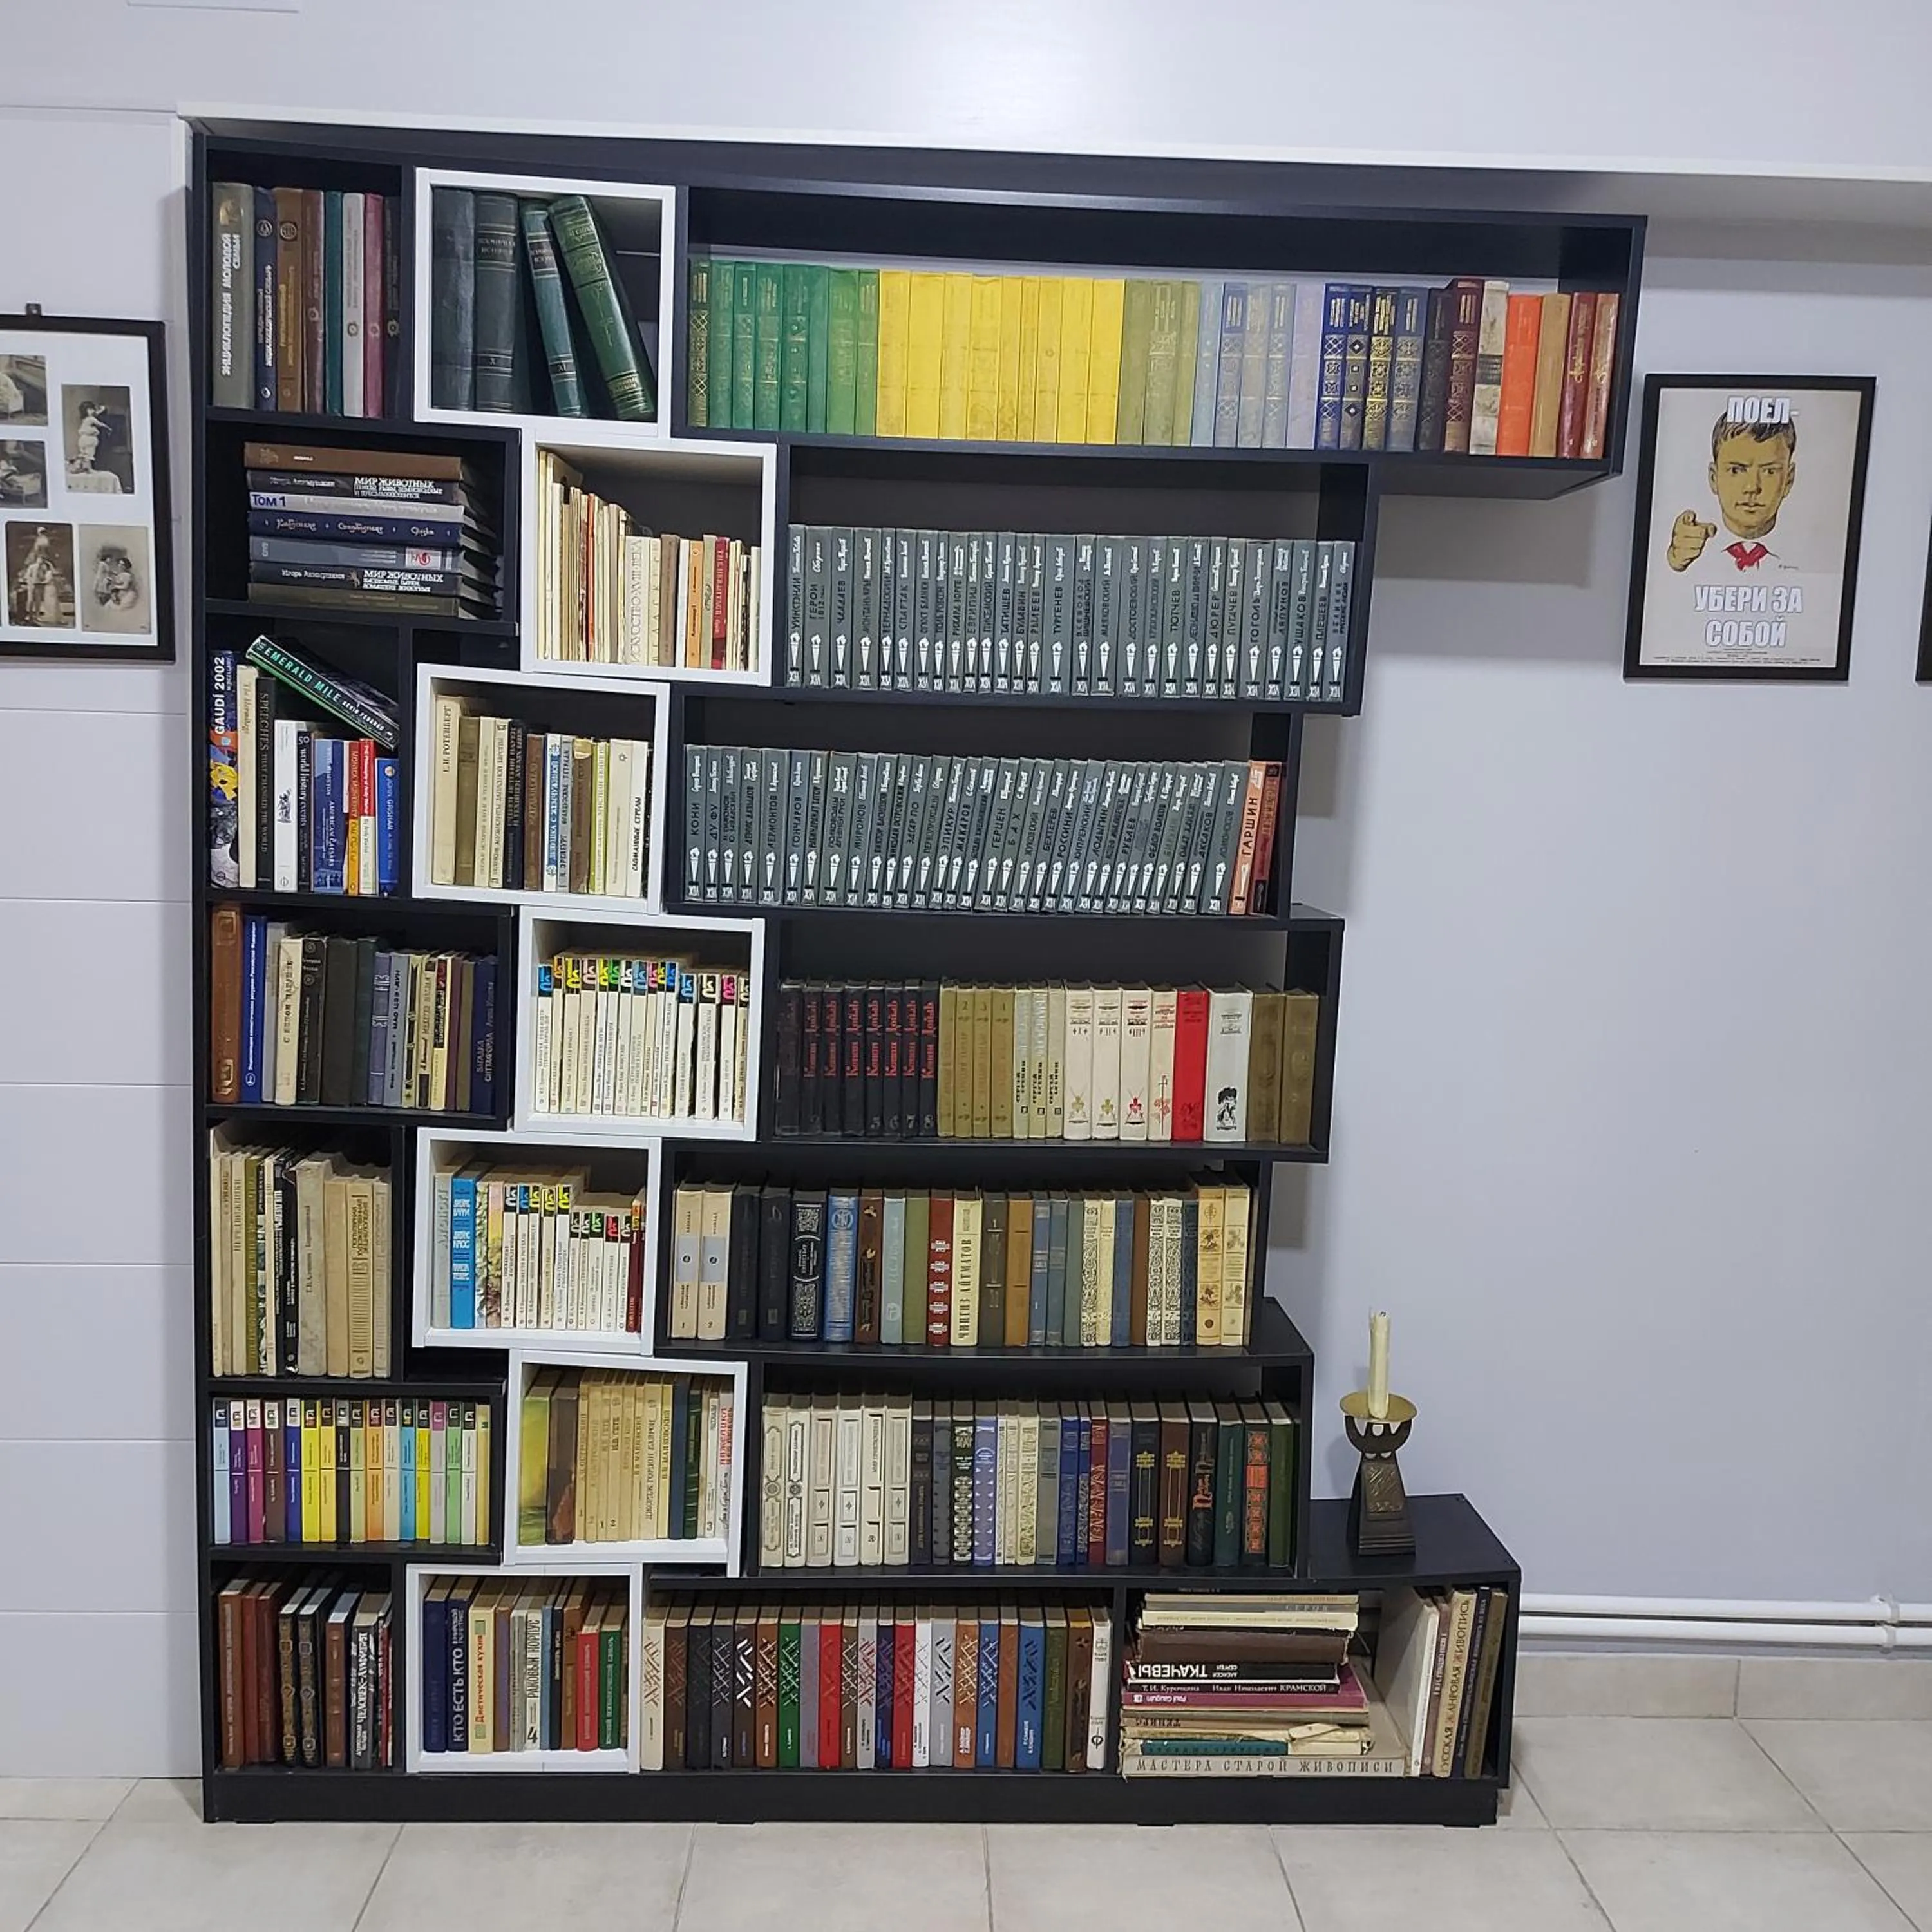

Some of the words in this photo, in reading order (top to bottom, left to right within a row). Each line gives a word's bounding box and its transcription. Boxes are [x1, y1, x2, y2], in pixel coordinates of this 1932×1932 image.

[222, 234, 232, 288] МОЛОДОЙ
[221, 292, 232, 376] ЭНЦИКЛОПЕДИЯ
[279, 497, 286, 507] 1
[355, 477, 378, 485] МИР
[379, 478, 434, 488] ЖИВОТНЫХ
[364, 569, 386, 578] МИР
[388, 571, 443, 582] ЖИВОТНЫХ
[810, 583, 818, 619] ГЕРОИ
[1017, 591, 1026, 635] БУЛАВИН
[1053, 586, 1062, 635] ТУРГЕНЕВ
[1170, 589, 1180, 632] ТЮТЧЕВ
[1211, 594, 1219, 639] ДЮРЕР
[1228, 591, 1238, 636] ПУГАЧЕВ
[1278, 581, 1288, 635] ЛЯПУНОВ
[1694, 585, 1768, 612] УБЕРИ
[1771, 586, 1803, 614] ЗА
[1250, 598, 1261, 643] ГОГОЛЬ
[1295, 596, 1307, 645] УШАКОВ
[1704, 616, 1787, 647] СОБОЙ
[214, 656, 225, 690] 2002
[264, 647, 313, 683] EMERALD
[314, 679, 341, 701] MILE
[213, 694, 225, 735] GAUDÍ
[260, 693, 270, 751] SPEECHES
[299, 748, 309, 772] world
[299, 773, 309, 800] history
[299, 801, 308, 826] events
[691, 802, 699, 836] КОНИ
[710, 803, 717, 820] ФУ
[767, 795, 777, 848] ЛЕРМОНТОВ
[791, 797, 801, 848] ГОНЧАРОВ
[911, 802, 919, 817] ПО
[942, 807, 954, 851] ЭПИКУР
[956, 804, 969, 852] МАКАРОВ
[991, 808, 1006, 848] ГЕРЦЕН
[1242, 797, 1258, 855] ГАРШИН
[710, 824, 717, 840] ДУ
[1057, 811, 1073, 858] РОССИНИ
[1092, 809, 1108, 857] ЛОДЫГИН
[1121, 817, 1135, 854] РУБЛЕВ
[1198, 812, 1213, 858] АКСАКОВ
[907, 1115, 915, 1128] 7
[958, 1239, 972, 1294] АЙТМАТОВ
[958, 1298, 971, 1339] ЧИНГИЗ
[477, 1635, 485, 1661] кухня
[1454, 1600, 1470, 1663] ЖИВОПИСЬ
[453, 1648, 464, 1674] КТО
[1138, 1664, 1208, 1678] ТКАЧЕВЫ
[453, 1678, 464, 1712] ЕСТЬ
[476, 1663, 485, 1723] Диетическая
[1280, 1683, 1327, 1692] КРАМСКОЙ
[453, 1714, 464, 1741] КТО
[1136, 1759, 1213, 1772] МАСТЕРА
[1224, 1758, 1287, 1772] СТАРОЙ
[1298, 1759, 1394, 1773] ЖИВОПИСИ
